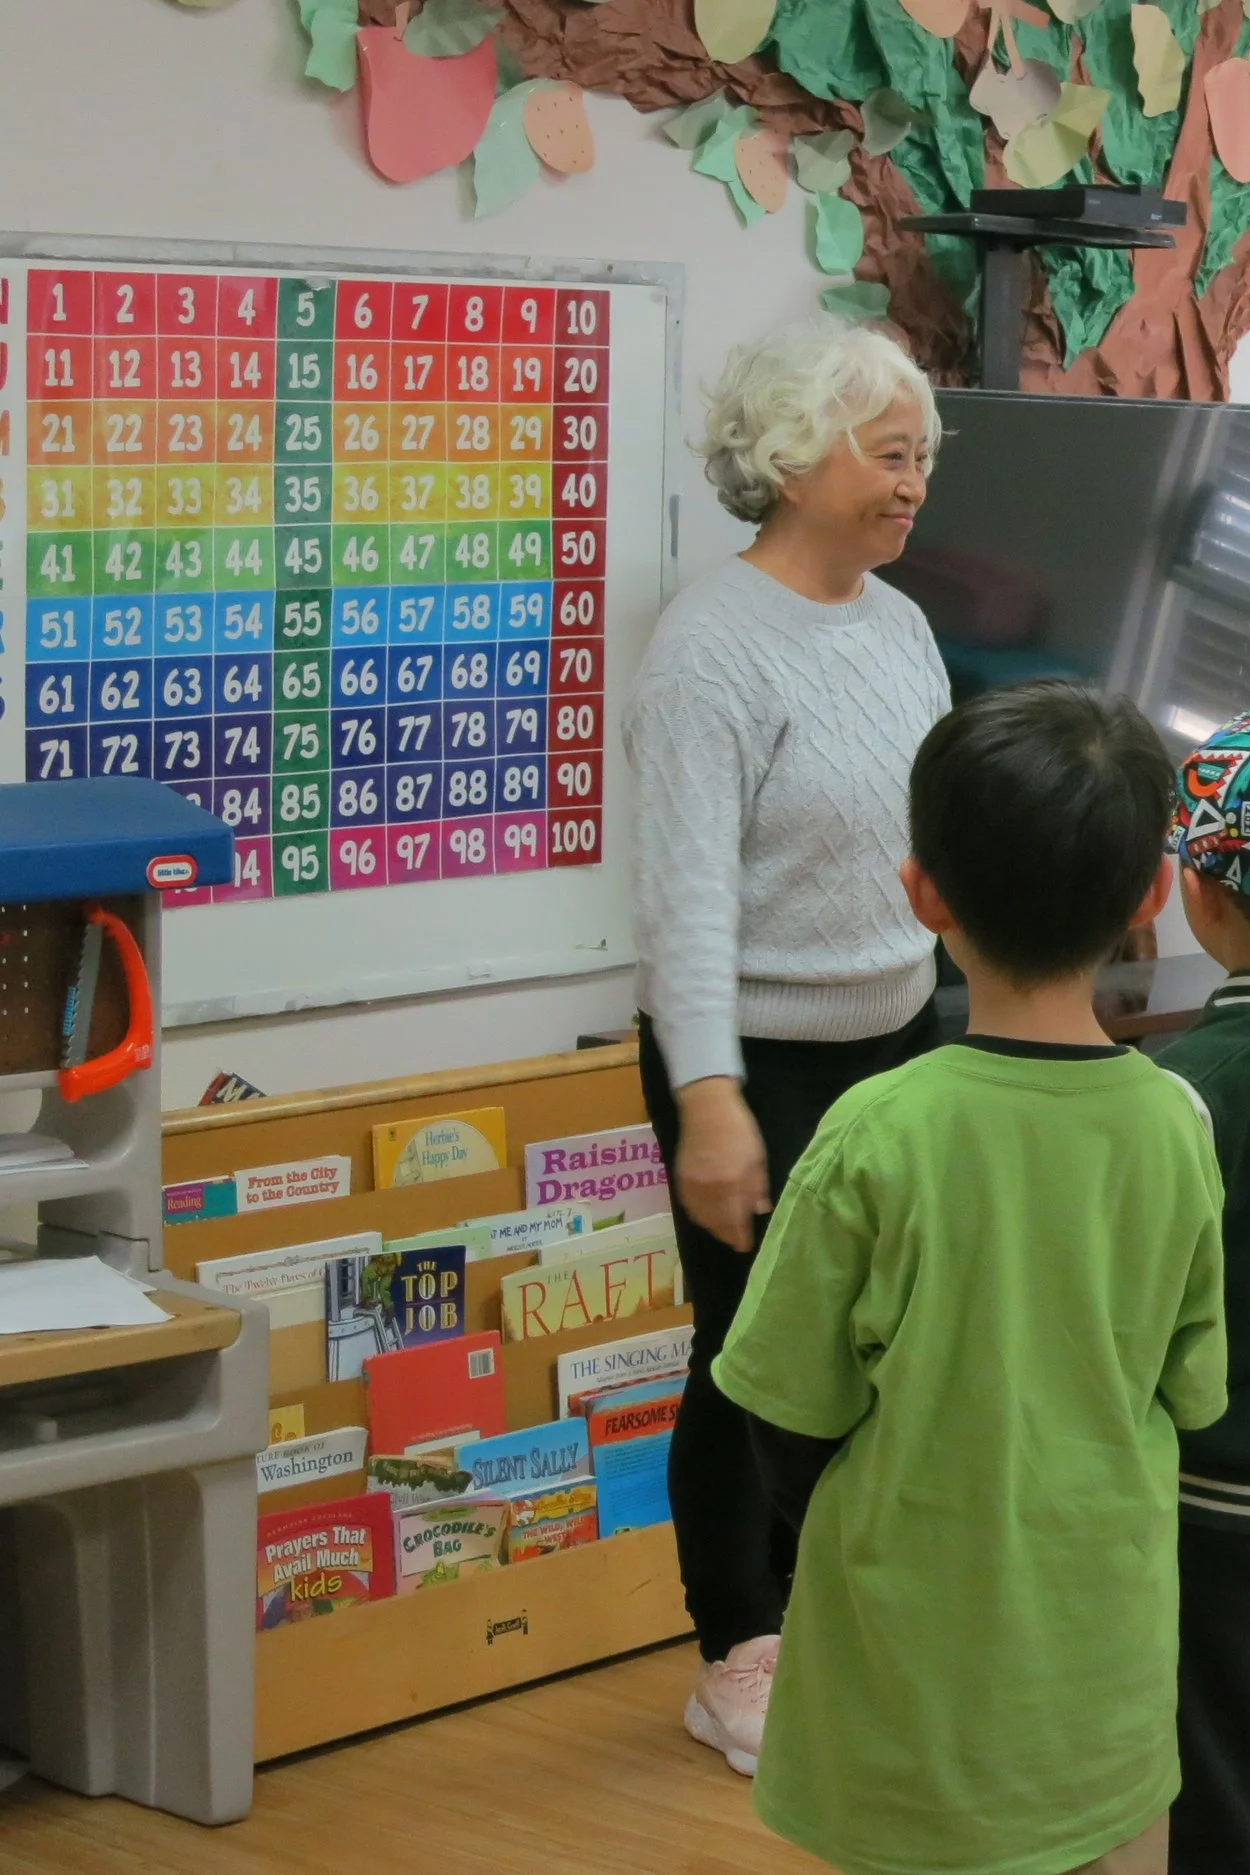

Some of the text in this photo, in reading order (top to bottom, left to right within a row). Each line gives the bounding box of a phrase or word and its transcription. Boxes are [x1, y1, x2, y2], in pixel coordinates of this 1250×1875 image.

[52, 283, 596, 335] 1 2 3 4 5 6 7 8 9 10
[45, 349, 597, 393] 11 12 13 14 15 16 17 18 19 20
[41, 414, 597, 452] 21 22 23 24 25 26 27 28 29 30
[40, 473, 596, 519] 31 32 33 34 35 36 37 38 39 40
[40, 531, 595, 583] 41 42 43 44 45 46 47 48 49 50
[40, 591, 594, 648] 51 52 53 54 55 56 57 58 59 60
[39, 648, 592, 714] 61 62 63 64 65 66 67 68 69 70
[40, 705, 593, 778] 71 72 73 74 75 76 77 78 79 80
[222, 788, 261, 826] 84
[280, 784, 320, 821] 85
[339, 779, 377, 816] 86
[396, 774, 432, 811] 87
[449, 770, 487, 806] 88
[504, 765, 538, 801] 89
[557, 762, 591, 796] 90
[282, 845, 319, 881] 95
[340, 839, 376, 875] 96
[397, 833, 430, 869] 97
[450, 828, 486, 864] 98
[504, 823, 536, 858] 99
[552, 819, 595, 853] 100
[425, 1128, 460, 1147] Herbie's
[421, 1145, 468, 1169] Happy Day
[541, 1140, 664, 1175] Raising
[246, 1180, 341, 1204] to the Country
[247, 1167, 338, 1189] From the City
[536, 1165, 668, 1205] Dragons
[167, 1195, 202, 1210] Reading
[498, 1218, 563, 1238] ME AND MY MOM
[417, 1261, 437, 1272] THE
[547, 1271, 569, 1285] THE
[401, 1271, 458, 1302] TOP
[518, 1250, 666, 1339] RAFT
[405, 1303, 458, 1335] JOB
[571, 1360, 601, 1379] THE
[604, 1345, 667, 1372] SINGING
[605, 1407, 668, 1436] FEARSOME
[261, 1450, 354, 1483] Washington
[473, 1455, 528, 1490] SILENT
[530, 1443, 579, 1479] SALLY
[265, 1531, 329, 1563] Prayers
[333, 1525, 367, 1546] That
[403, 1521, 496, 1553] CROCODILE'S
[433, 1539, 462, 1558] BAG
[273, 1548, 359, 1583] Avail Much
[290, 1572, 343, 1601] kids
